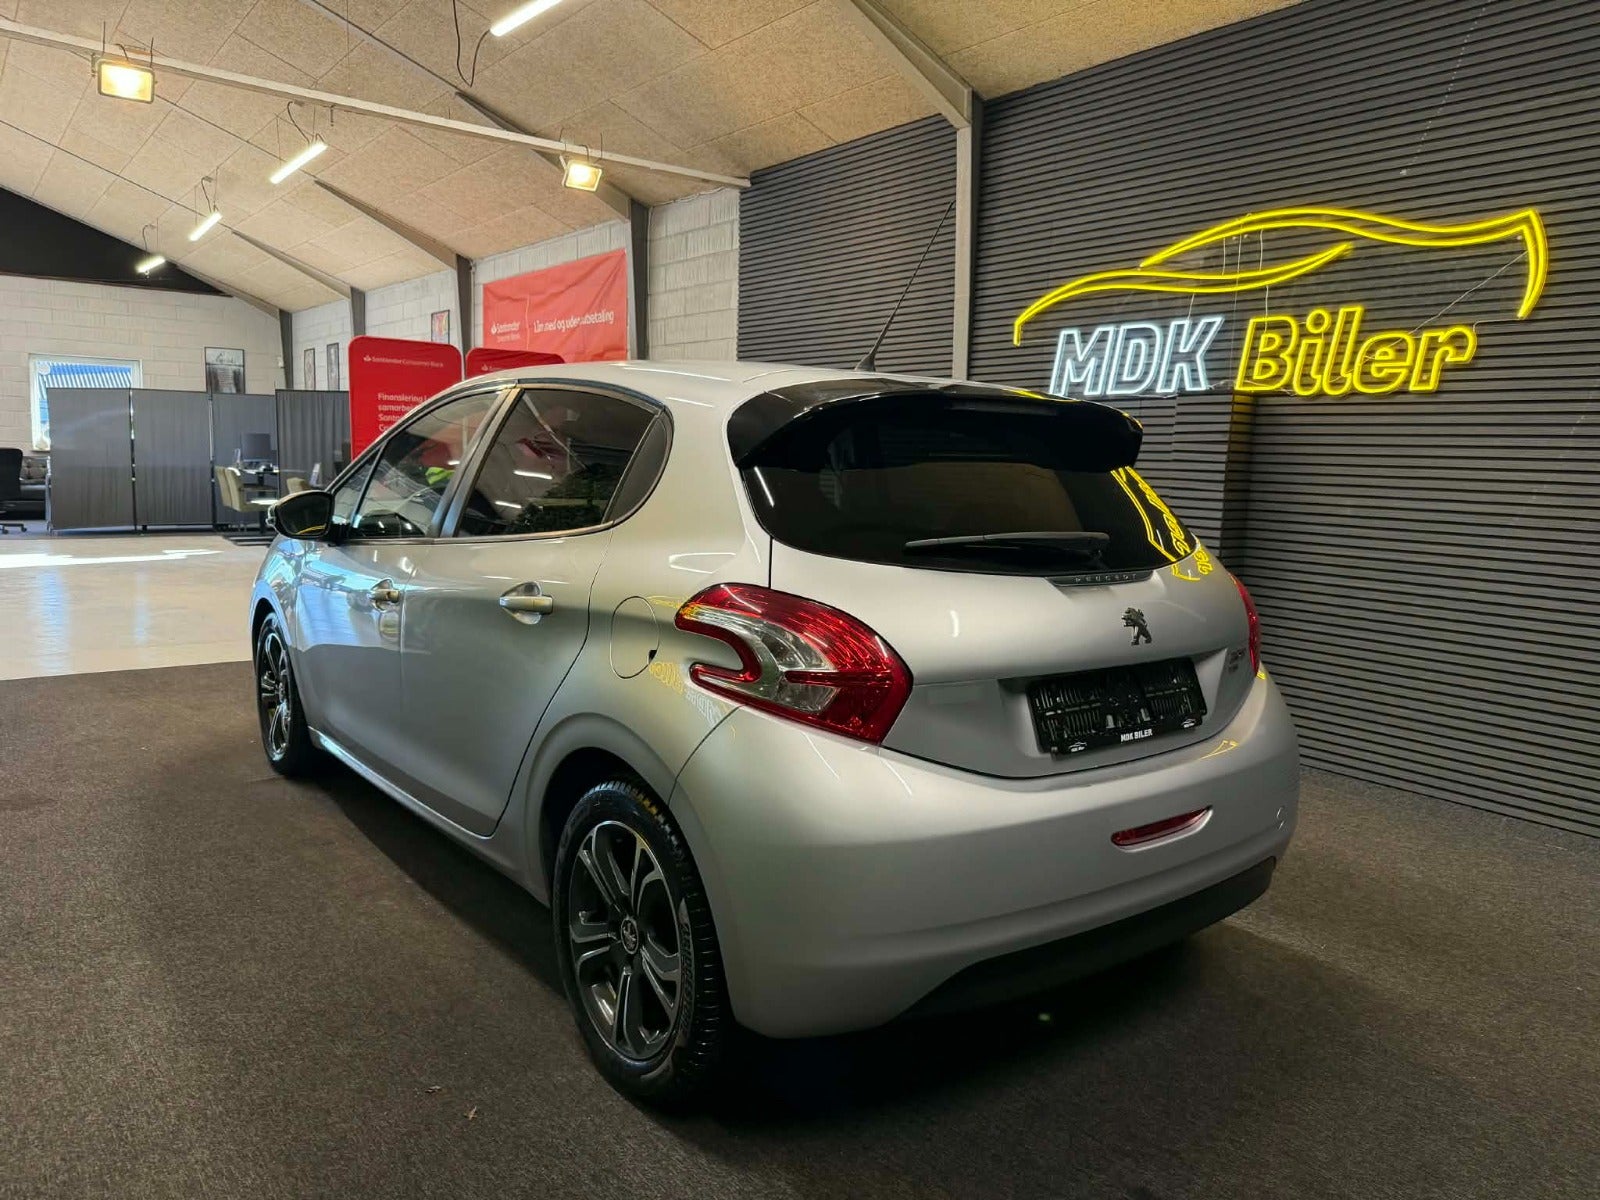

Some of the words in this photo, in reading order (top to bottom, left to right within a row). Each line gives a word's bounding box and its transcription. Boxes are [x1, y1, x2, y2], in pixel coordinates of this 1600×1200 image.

[557, 319, 566, 333] og
[1049, 315, 1224, 397] MDK
[1234, 306, 1477, 397] Biler
[378, 392, 423, 404] Finansiering
[1134, 728, 1153, 740] BILER
